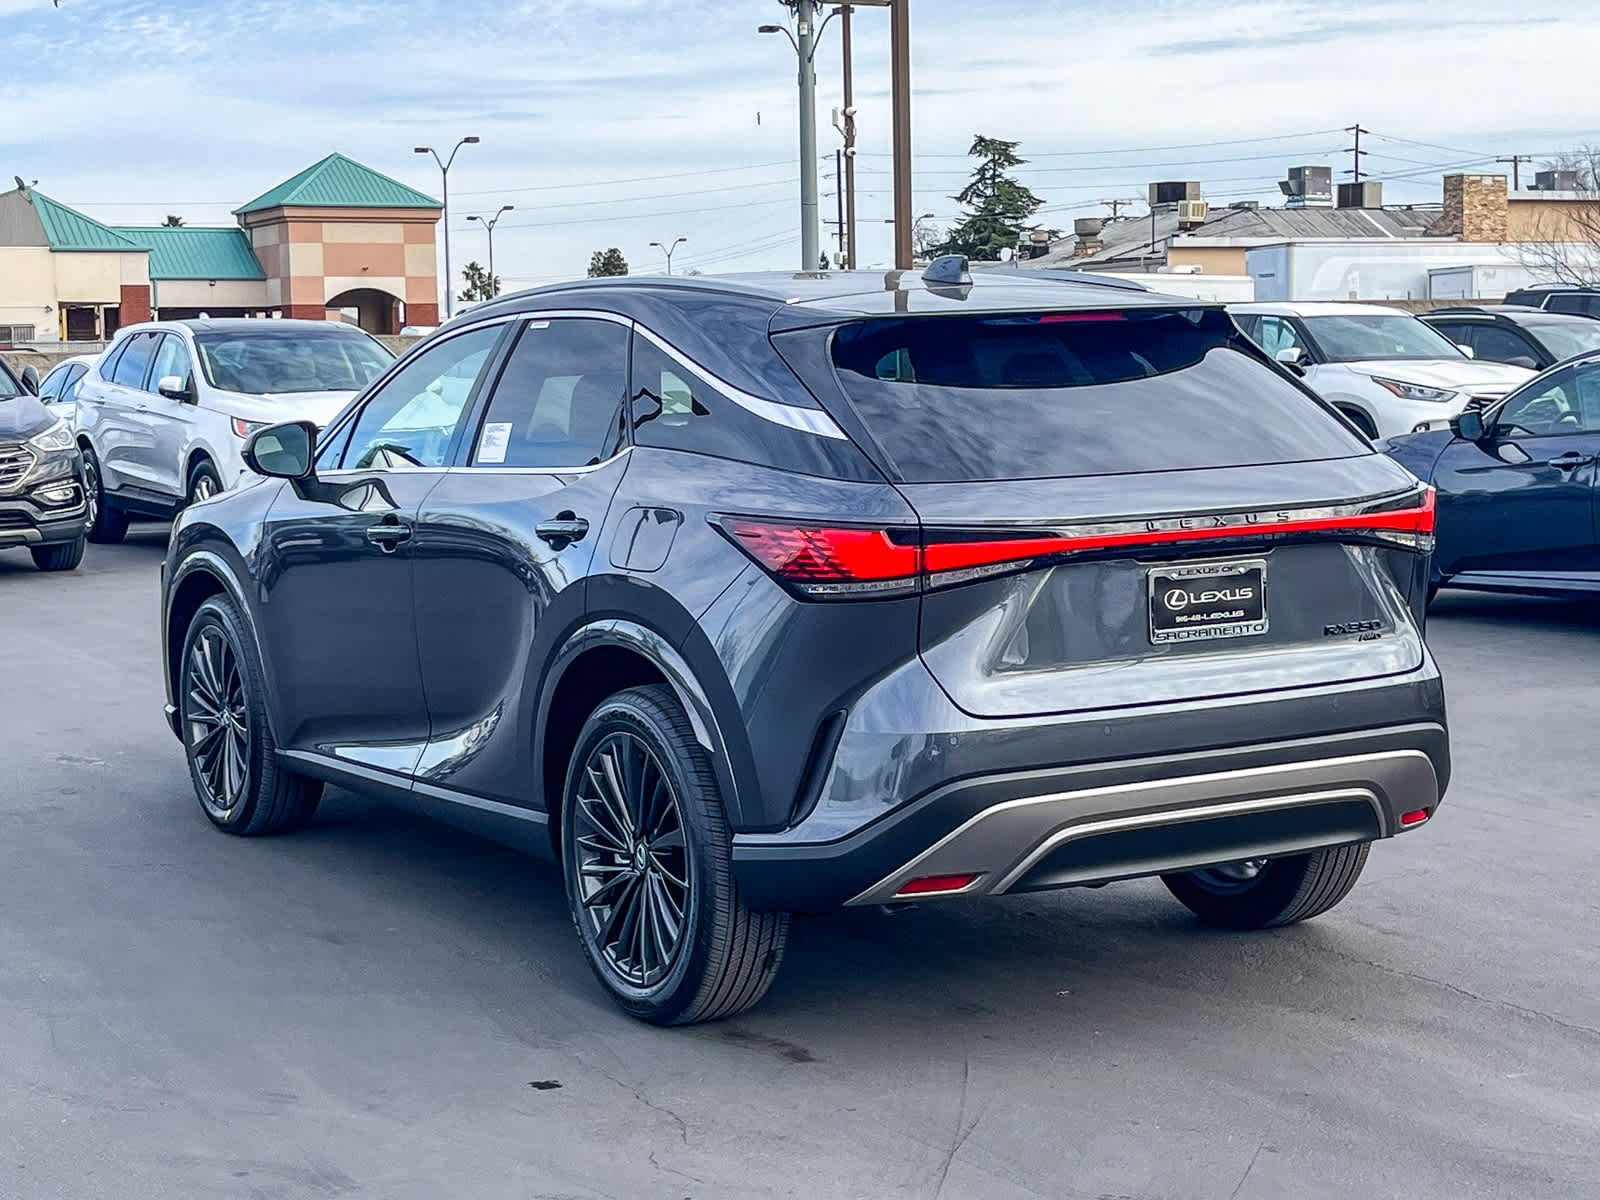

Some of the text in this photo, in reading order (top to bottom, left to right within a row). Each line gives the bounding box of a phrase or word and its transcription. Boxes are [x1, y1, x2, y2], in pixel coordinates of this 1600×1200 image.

[1145, 511, 1290, 533] LEXUS
[1178, 566, 1220, 577] LEXUS
[1189, 587, 1254, 604] LEXUS
[1155, 623, 1265, 641] SACRAMENTO
